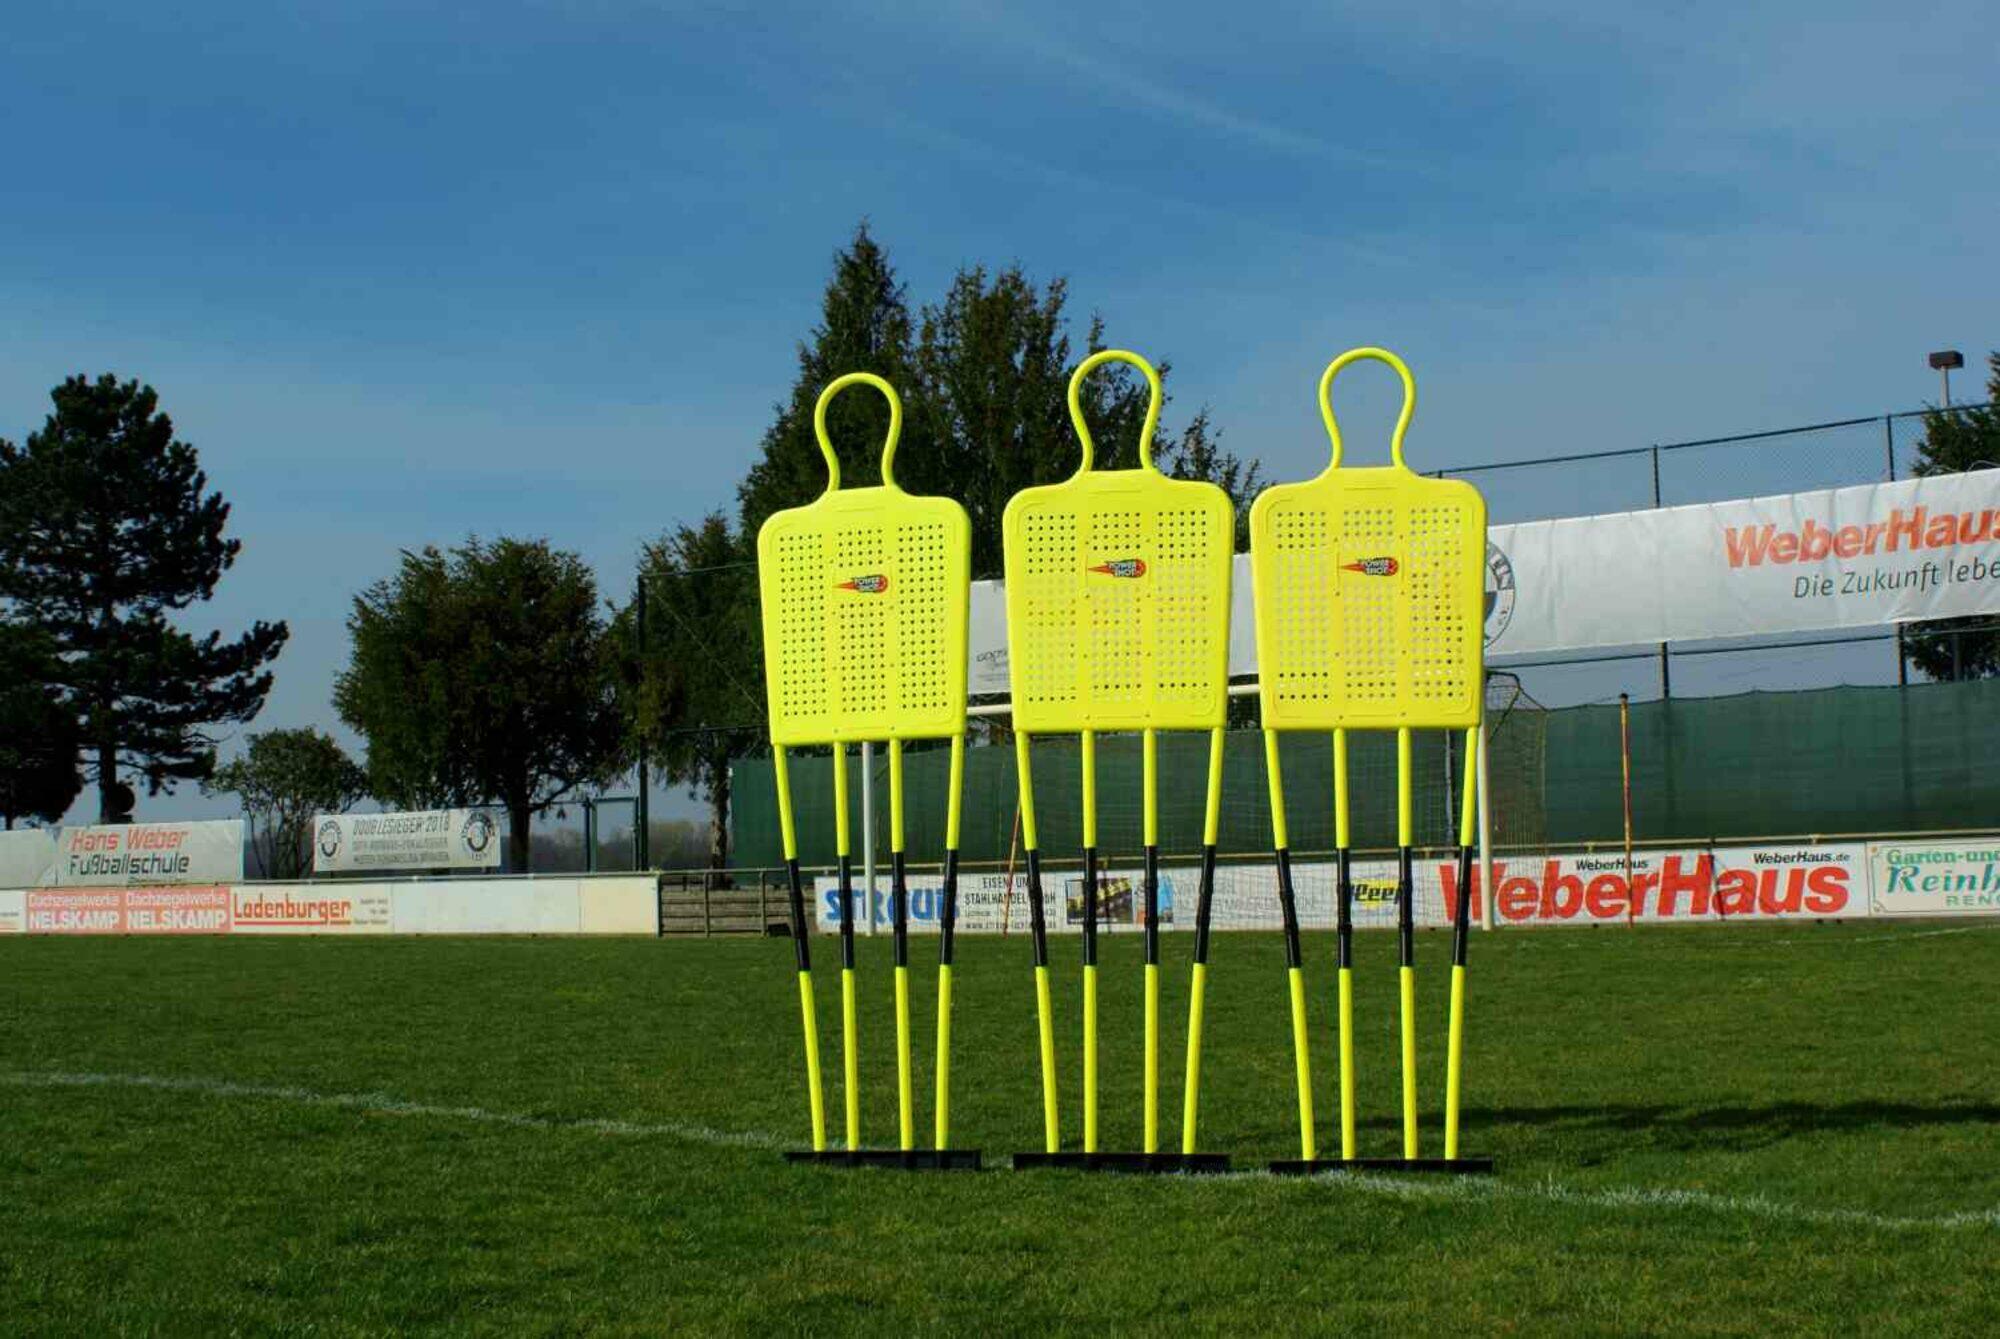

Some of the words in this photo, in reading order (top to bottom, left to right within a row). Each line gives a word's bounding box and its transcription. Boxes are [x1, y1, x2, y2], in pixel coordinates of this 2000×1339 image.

[1794, 574, 1833, 598] Die
[1841, 561, 1945, 595] Zukunft
[71, 830, 119, 851] Hans
[127, 828, 188, 850] Weber
[70, 854, 190, 875] Fußballschule
[1754, 853, 1850, 866] WeberHaus.de
[1439, 853, 1848, 922] WeberHaus
[234, 893, 351, 922] Ladenburger
[964, 892, 1026, 905] STAHLHADEL
[30, 910, 120, 930] NELSKAMP
[127, 909, 226, 929] NELSKAMP
